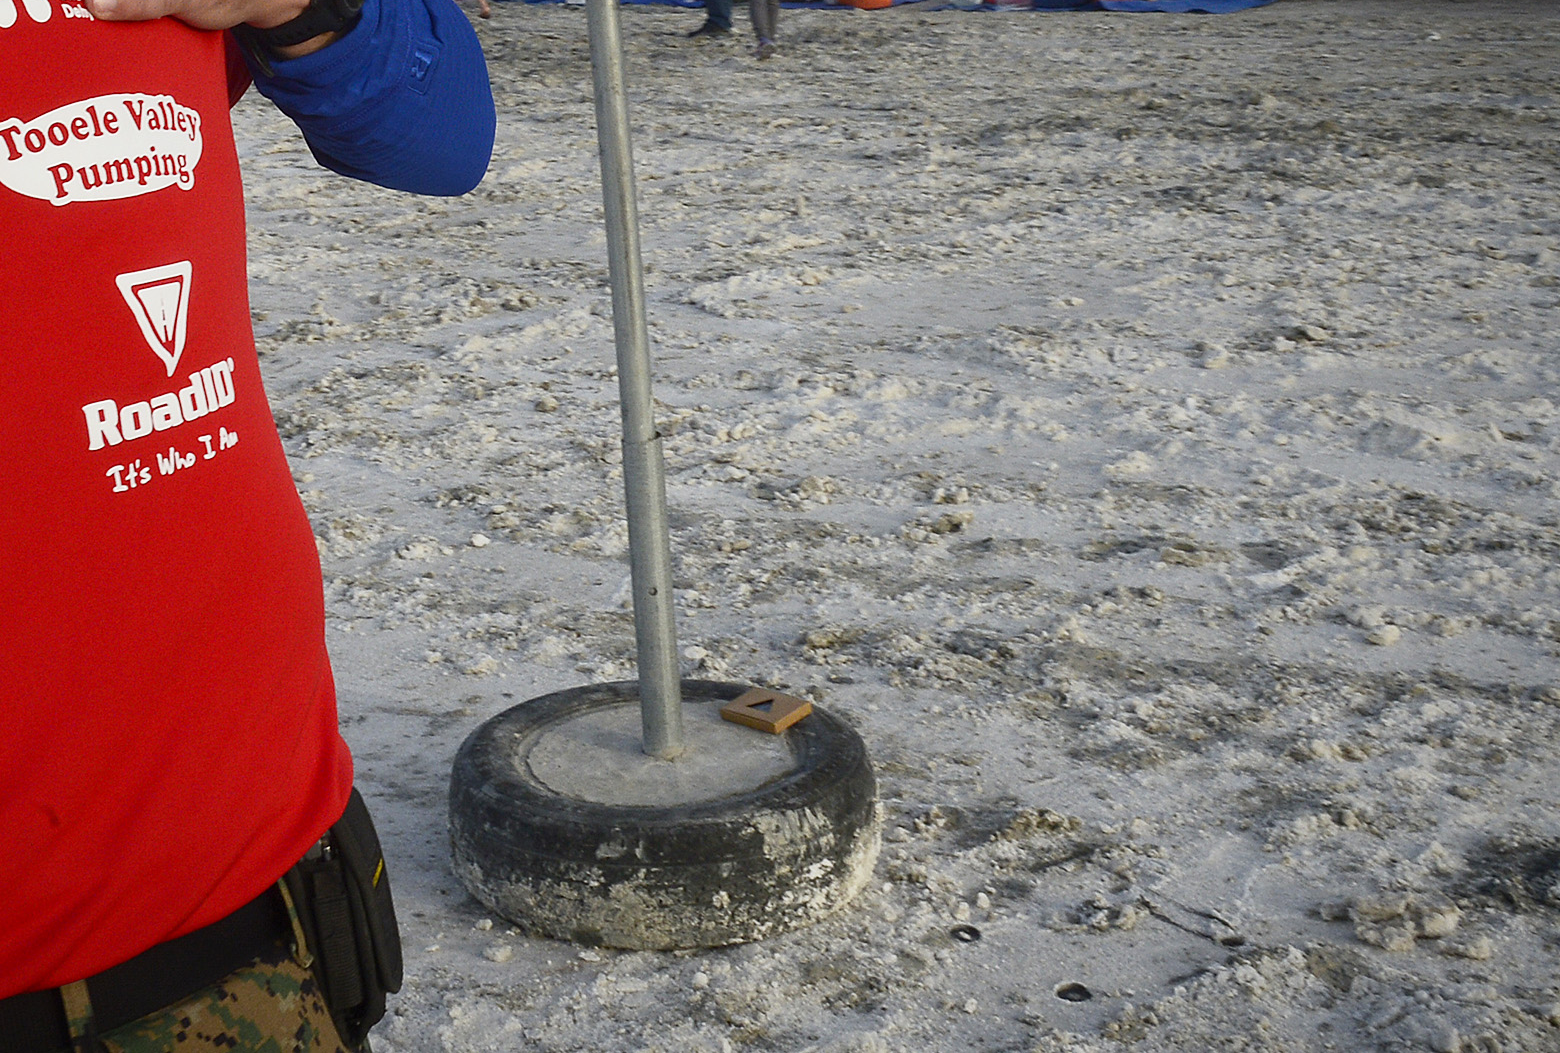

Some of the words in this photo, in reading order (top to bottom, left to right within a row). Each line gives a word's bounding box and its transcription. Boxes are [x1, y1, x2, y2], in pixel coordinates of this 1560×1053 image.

[123, 99, 197, 141] Valley
[47, 146, 189, 198] Pumping
[106, 459, 152, 493] It's
[156, 447, 196, 475] Who
[198, 435, 216, 460] I
